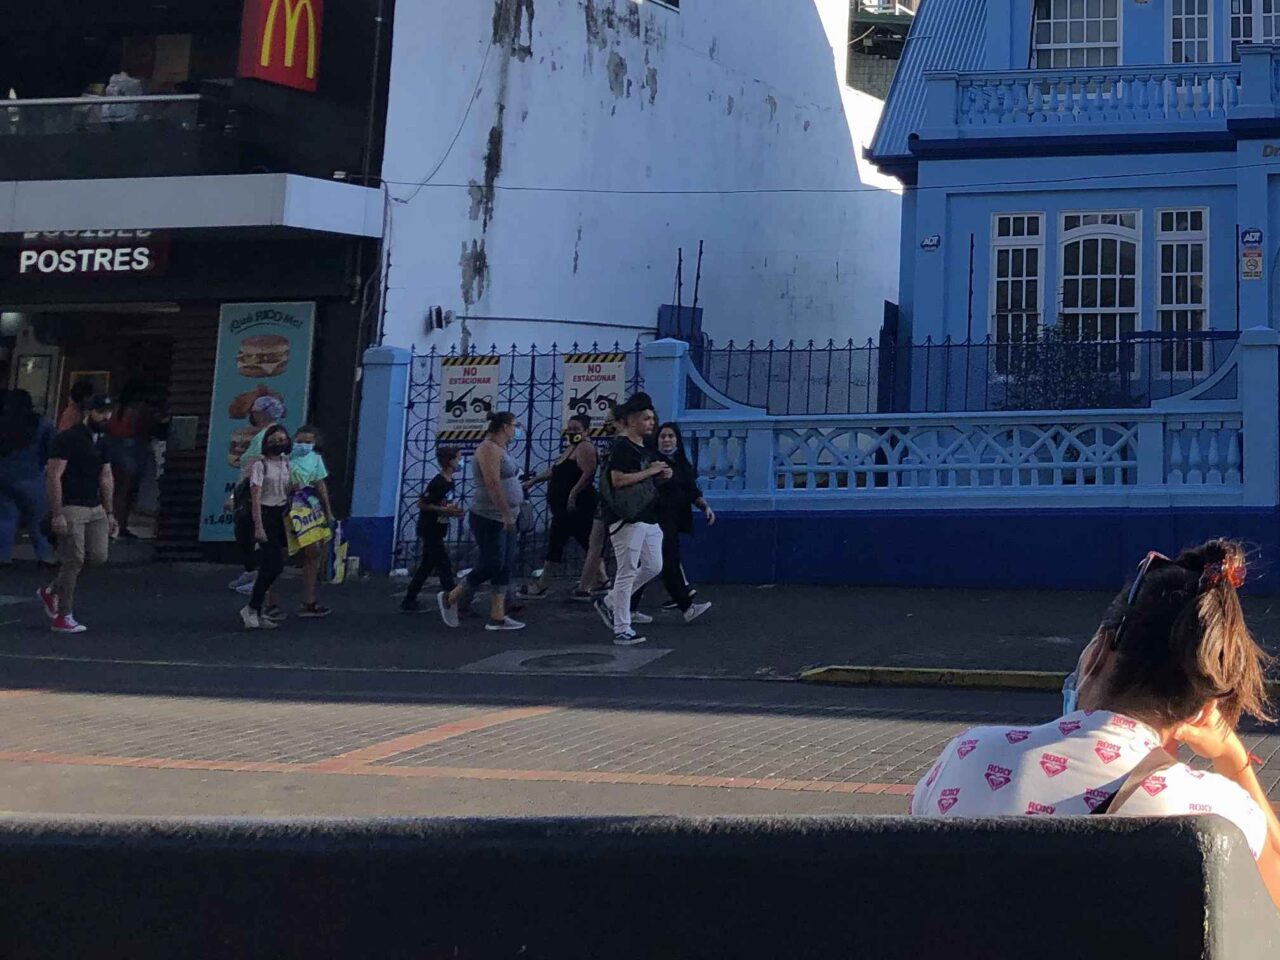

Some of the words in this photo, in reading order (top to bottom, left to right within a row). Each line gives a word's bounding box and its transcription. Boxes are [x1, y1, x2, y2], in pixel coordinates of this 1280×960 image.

[1243, 232, 1260, 242] ADT
[19, 247, 150, 273] POSTRES
[463, 367, 477, 376] NO
[587, 364, 602, 374] NO
[449, 376, 492, 385] ESTACIONAR
[572, 374, 616, 382] ESTACIONAR
[1112, 715, 1137, 728] ROXY
[1096, 740, 1121, 751] ROXY
[1042, 753, 1068, 765] ROXY
[987, 764, 1013, 776] ROXY
[941, 788, 960, 796] ROXY
[1028, 801, 1056, 815] ROXY
[1189, 803, 1212, 811] ROXY
